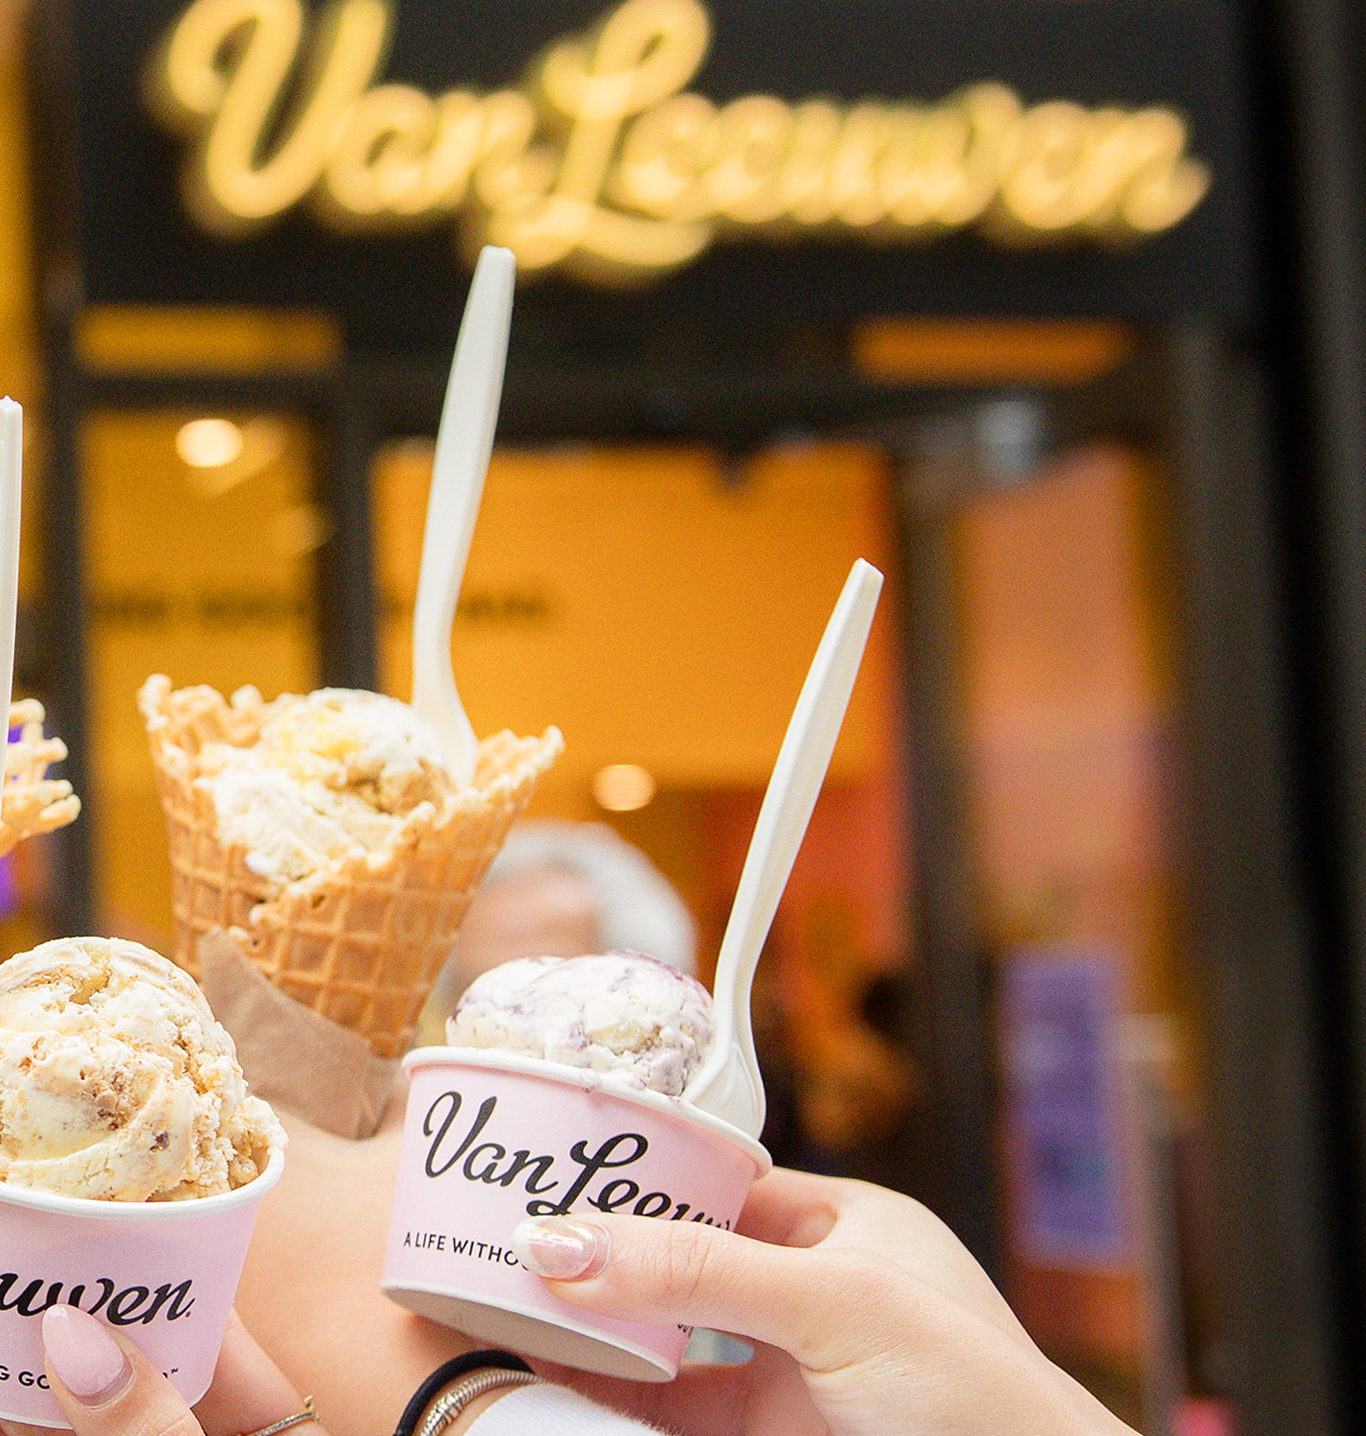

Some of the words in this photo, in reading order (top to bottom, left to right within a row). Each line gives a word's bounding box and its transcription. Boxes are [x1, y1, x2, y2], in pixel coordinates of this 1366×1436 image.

[164, 0, 550, 217] Van
[422, 1090, 559, 1195] Van
[403, 1231, 412, 1248] A
[414, 1232, 447, 1252] LIFE
[452, 1237, 530, 1272] WITHO
